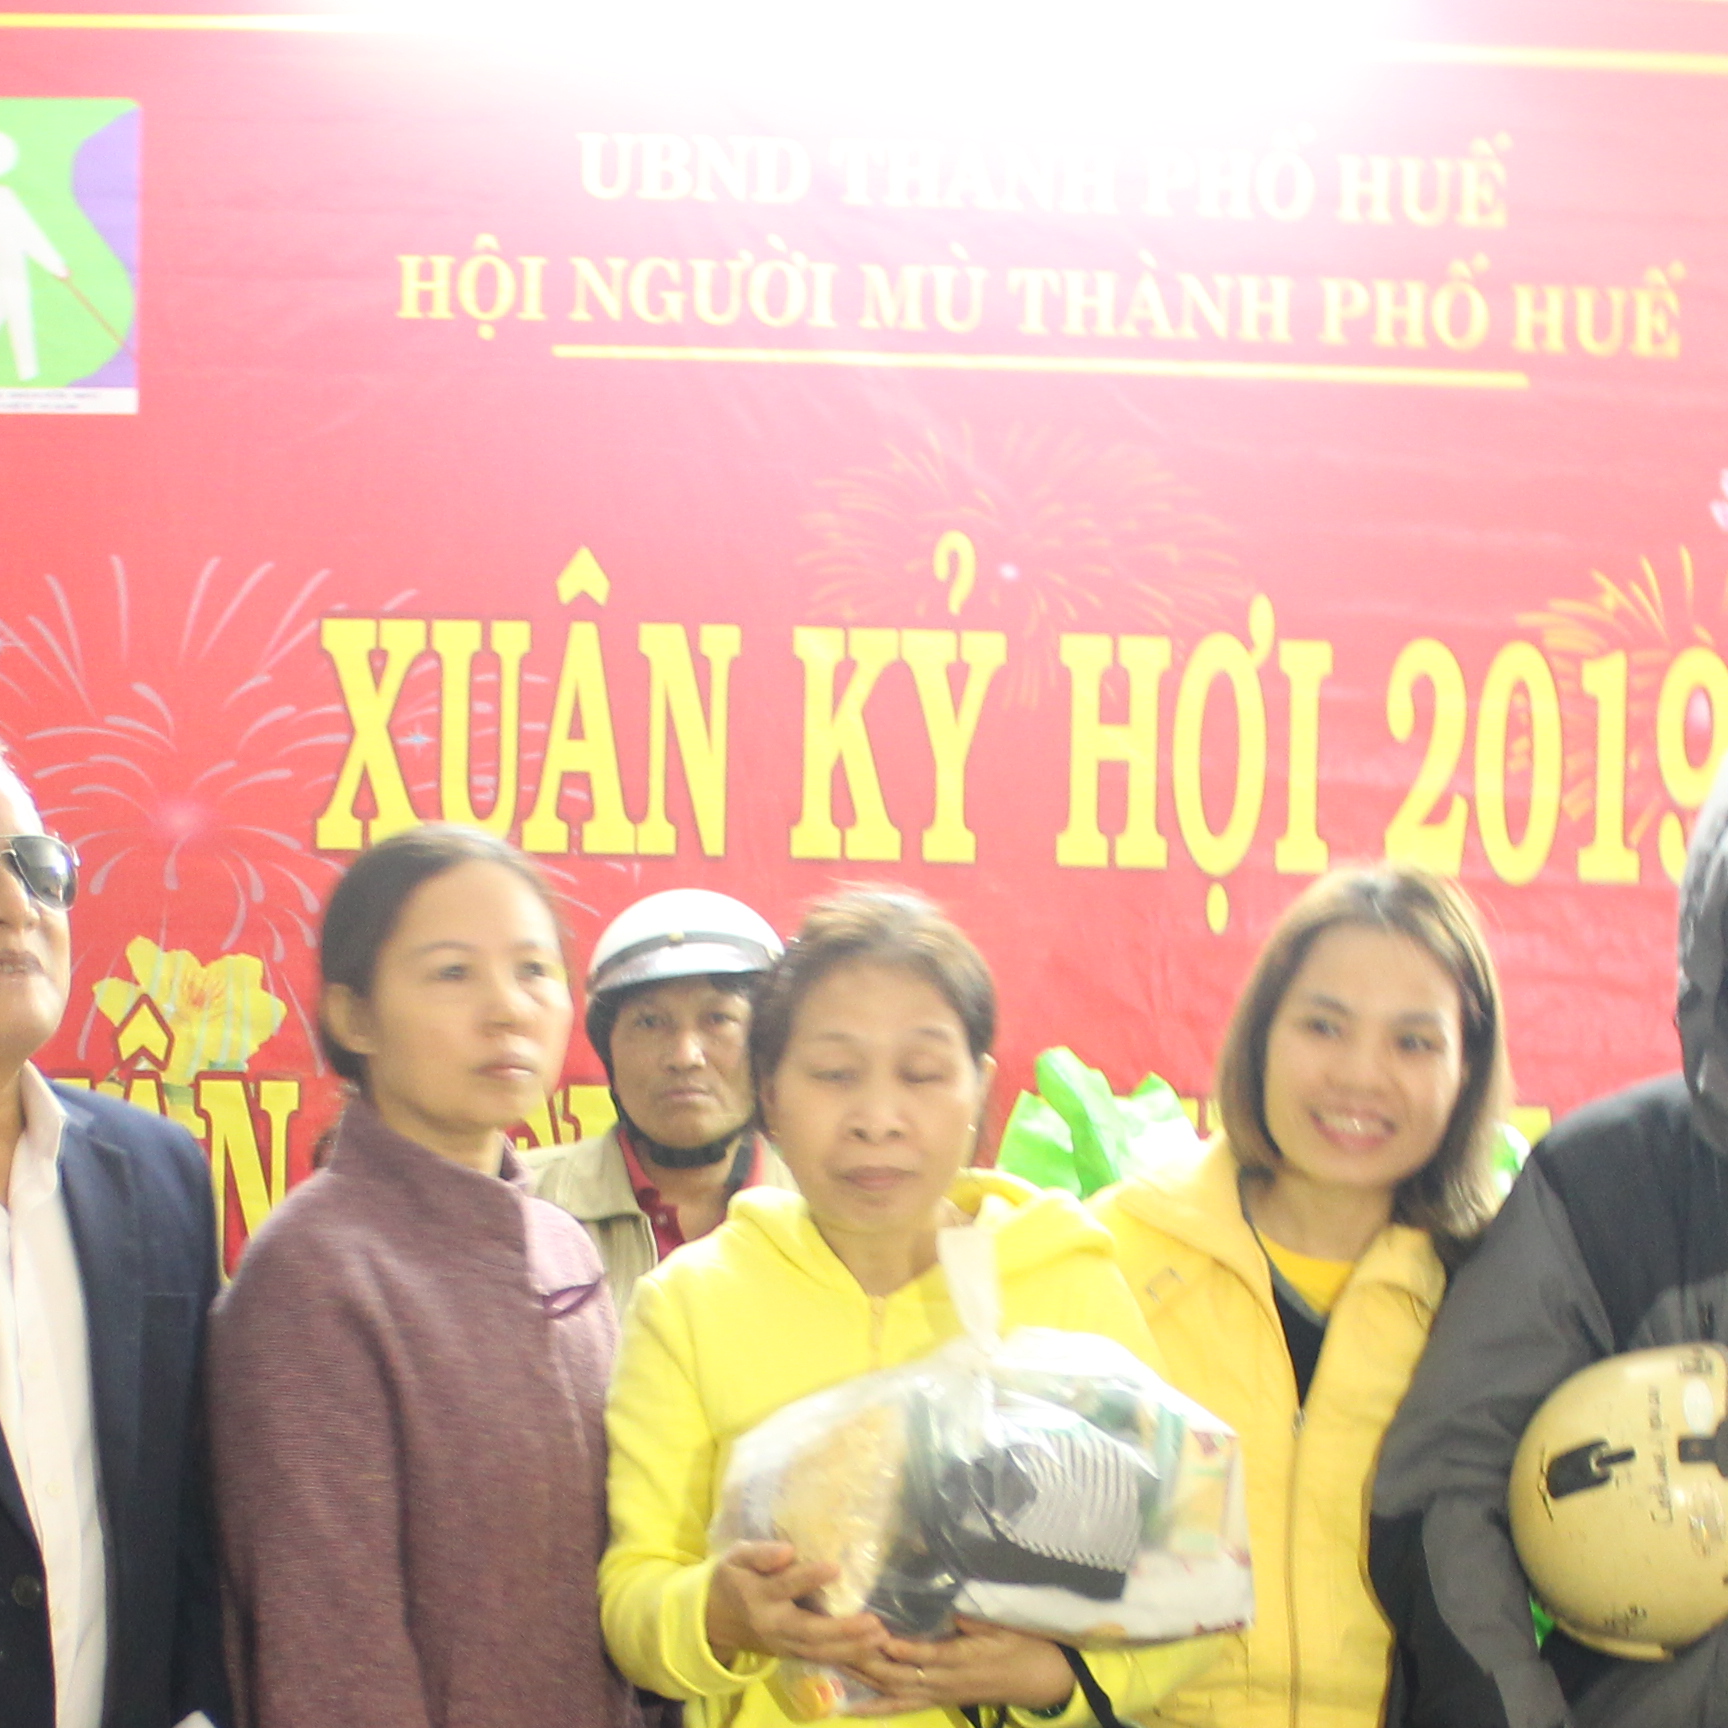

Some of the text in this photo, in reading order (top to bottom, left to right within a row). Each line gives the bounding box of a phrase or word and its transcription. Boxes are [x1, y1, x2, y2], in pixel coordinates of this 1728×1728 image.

[575, 130, 813, 203] UBND
[1334, 130, 1510, 230] HUẾ
[395, 232, 1686, 359] HỘI NGƯỜI MÙ THÀNH PHỐ HUẾ
[314, 545, 742, 860] XUÂN
[789, 530, 1008, 865] KỶ
[1055, 592, 1334, 934] HỢI
